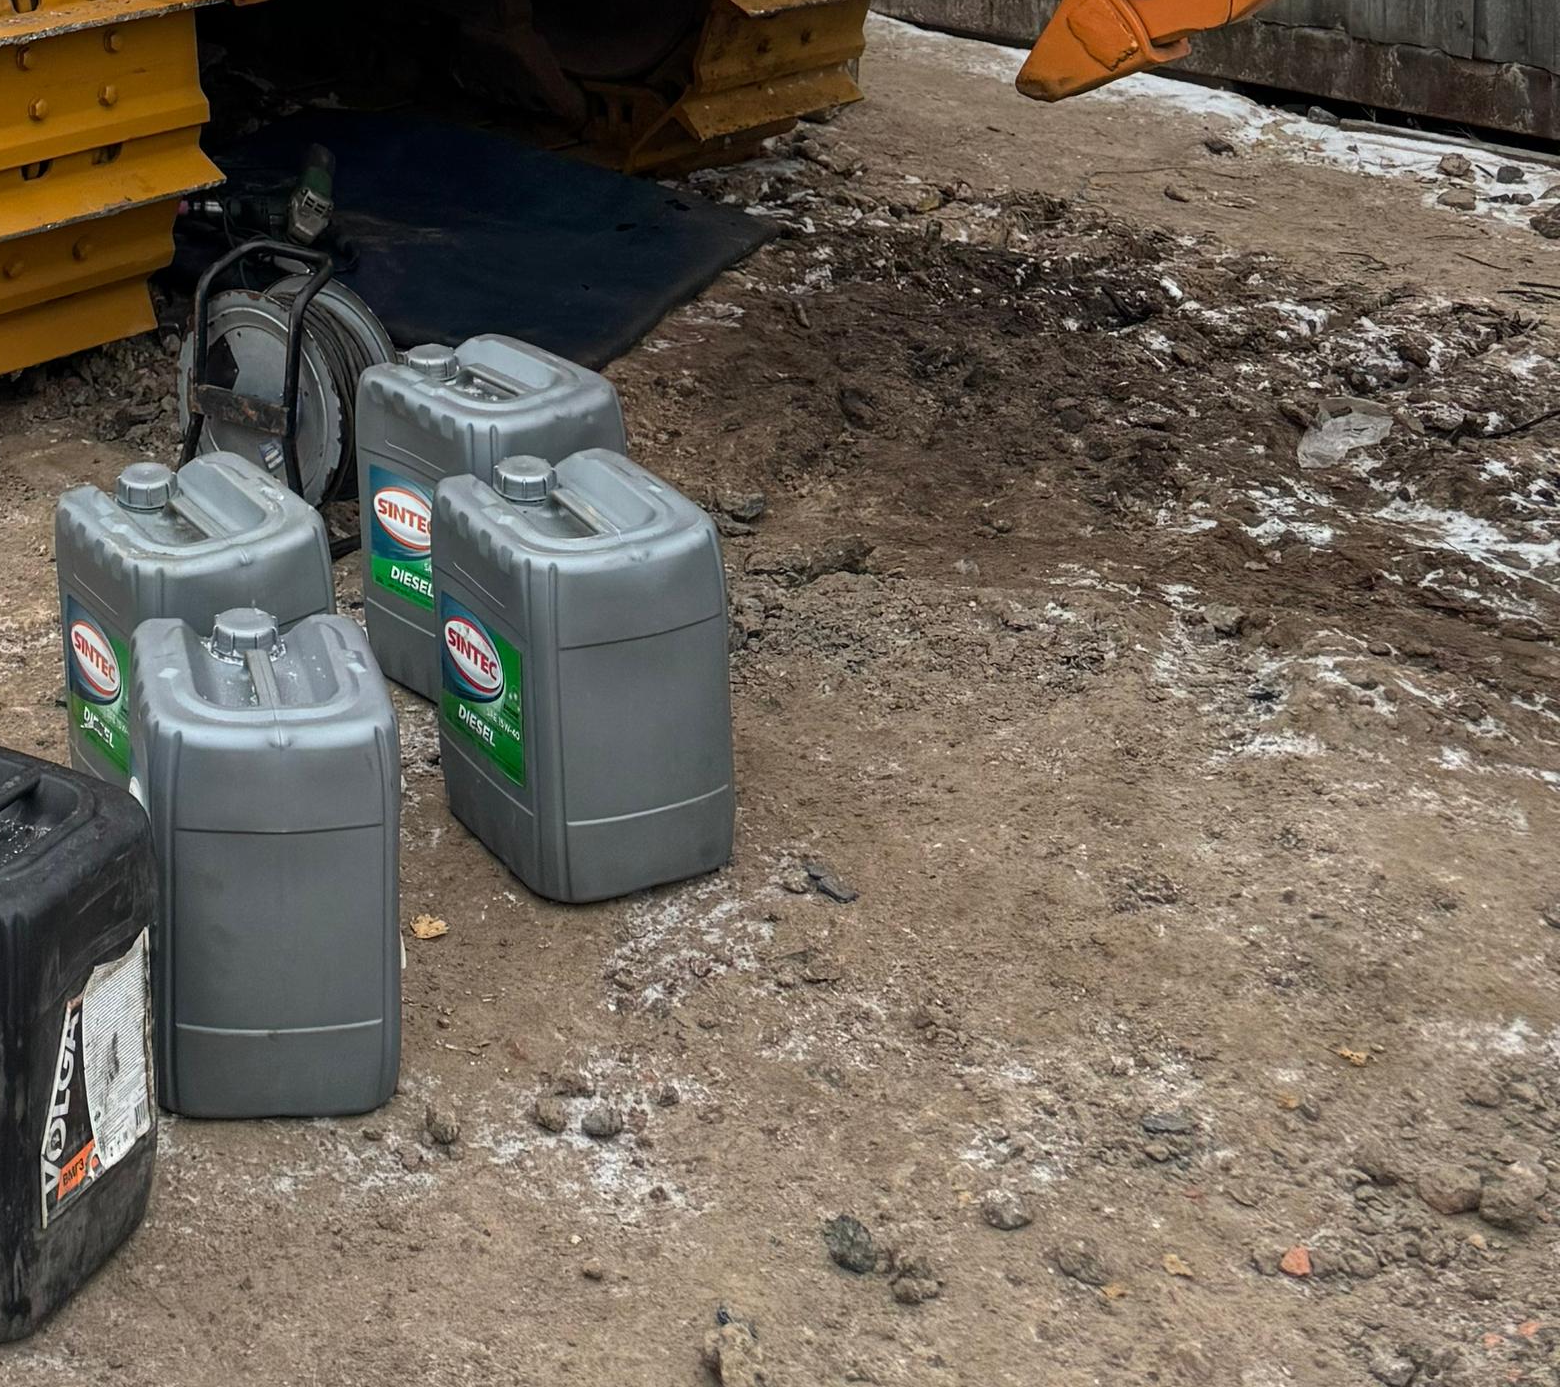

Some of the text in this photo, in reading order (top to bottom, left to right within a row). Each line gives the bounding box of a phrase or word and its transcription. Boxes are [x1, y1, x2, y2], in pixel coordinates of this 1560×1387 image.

[390, 565, 434, 598] DIESEL
[74, 630, 116, 684] SINTEC
[447, 627, 498, 681] SINTEC
[458, 703, 496, 747] DIESEL
[42, 1011, 81, 1195] VOLGA
